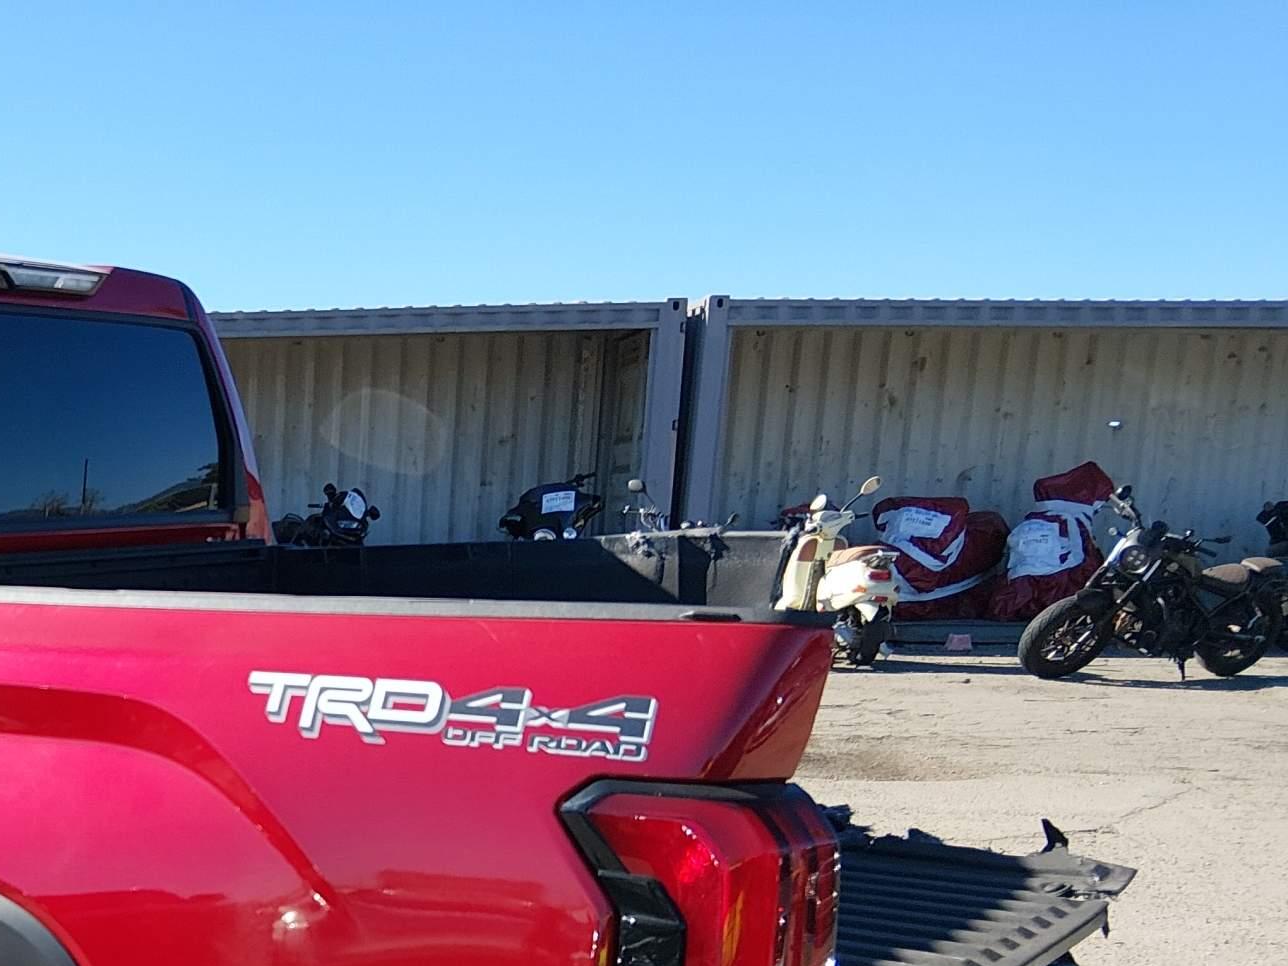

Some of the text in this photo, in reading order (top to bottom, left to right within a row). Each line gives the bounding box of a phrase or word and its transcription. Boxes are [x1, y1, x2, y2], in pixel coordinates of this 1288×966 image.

[248, 670, 658, 744] TRD 4x4
[441, 726, 648, 763] OFF ROAD
